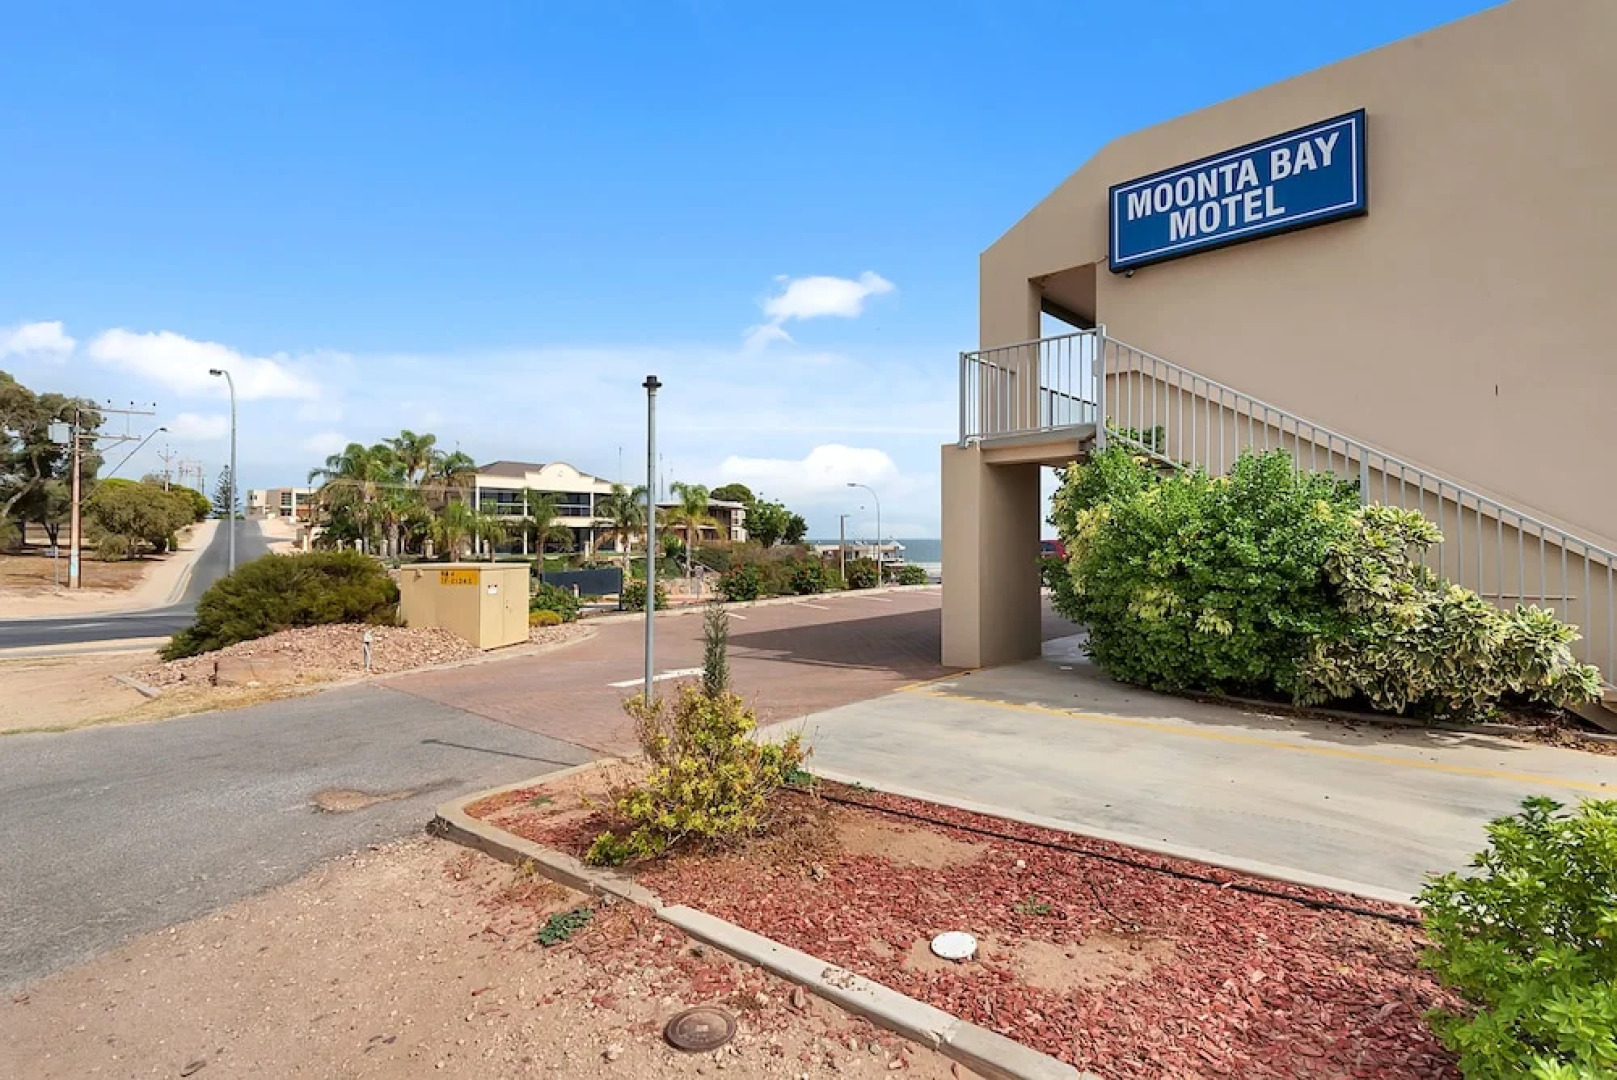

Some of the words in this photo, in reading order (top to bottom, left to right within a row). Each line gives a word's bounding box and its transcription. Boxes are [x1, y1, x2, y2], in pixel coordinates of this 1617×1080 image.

[1127, 158, 1259, 221] MOONTA
[1270, 131, 1340, 182] BAY
[1169, 185, 1286, 242] MOTEL
